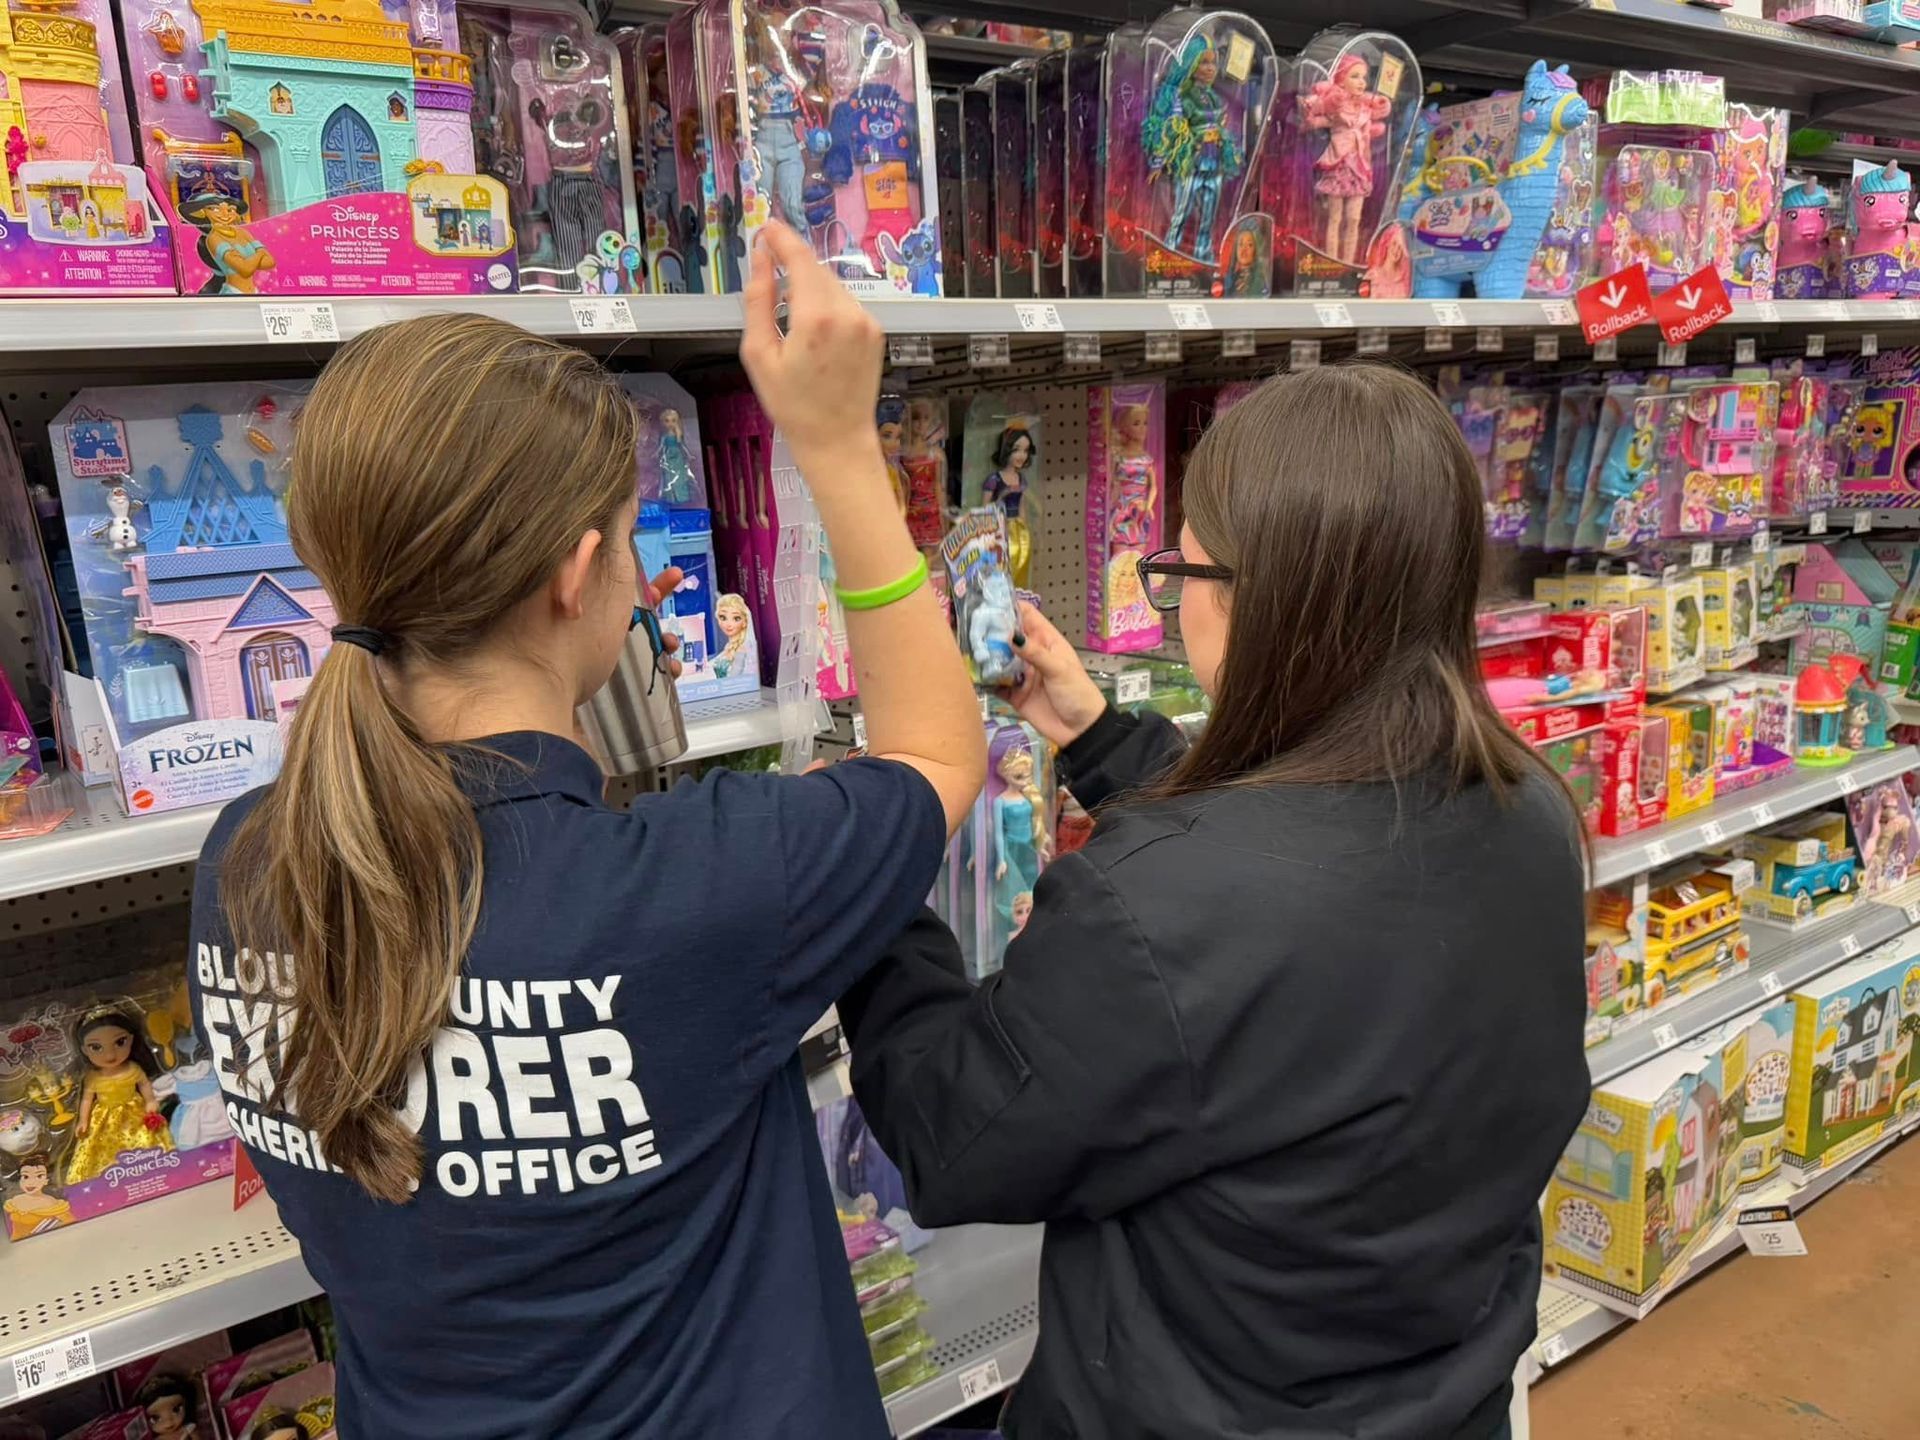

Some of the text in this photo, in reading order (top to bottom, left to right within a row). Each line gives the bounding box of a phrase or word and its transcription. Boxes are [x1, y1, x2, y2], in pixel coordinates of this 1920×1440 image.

[859, 99, 897, 110] STITCH
[328, 204, 380, 224] Disney
[311, 224, 400, 240] PRINCESS
[77, 250, 111, 262] WARNING:
[474, 271, 511, 282] 3+ MATTEL
[848, 280, 875, 291] stitch
[1588, 303, 1648, 340] Rollback
[1668, 303, 1726, 342] Rollback
[73, 458, 128, 468] Storytime
[1109, 608, 1153, 637] Barbie
[181, 731, 216, 743] Disney
[149, 734, 254, 773] FROZEN
[132, 780, 142, 788] 3+
[197, 941, 622, 1029] BLOU UNTY
[120, 1148, 164, 1164] Disney
[436, 1129, 663, 1198] OFFICE
[104, 1151, 181, 1188] PRINCESS
[238, 1174, 266, 1203] Rol
[1760, 1232, 1782, 1245] $25
